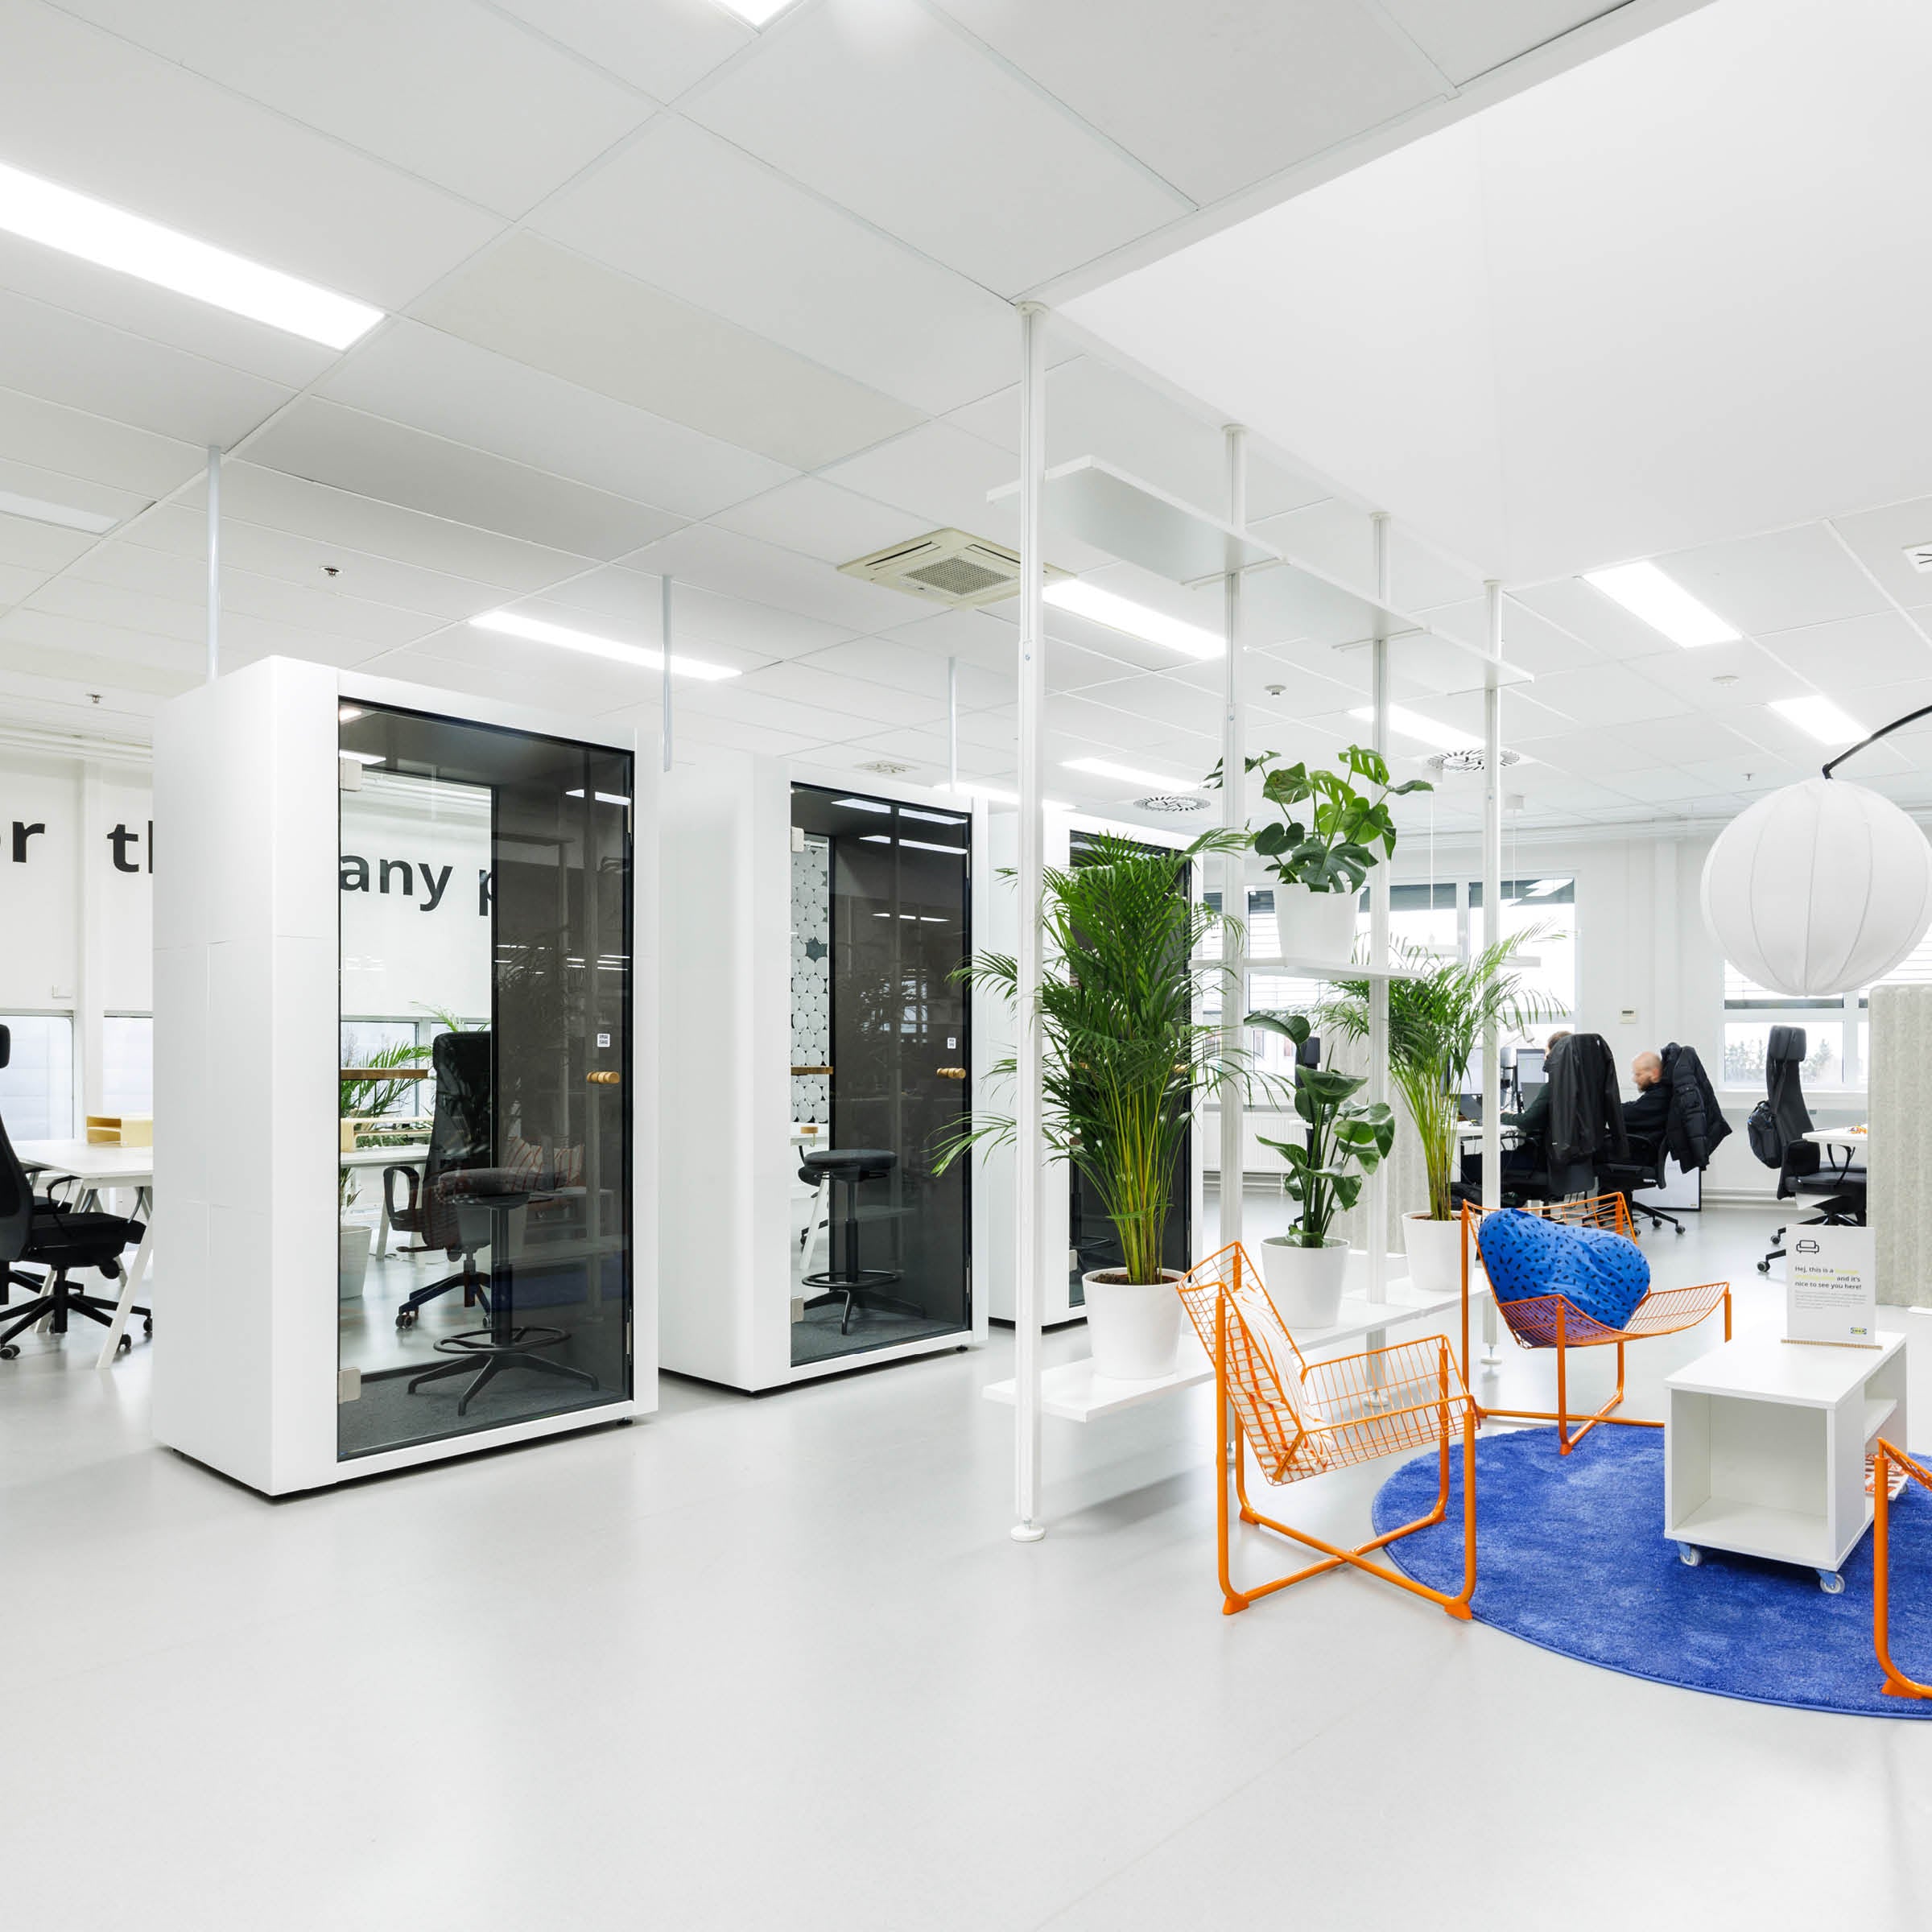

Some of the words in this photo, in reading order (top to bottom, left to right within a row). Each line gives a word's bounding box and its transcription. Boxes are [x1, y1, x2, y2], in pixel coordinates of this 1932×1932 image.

[0, 821, 45, 863] r
[107, 820, 153, 873] t
[1794, 1265, 1807, 1274] Hej,
